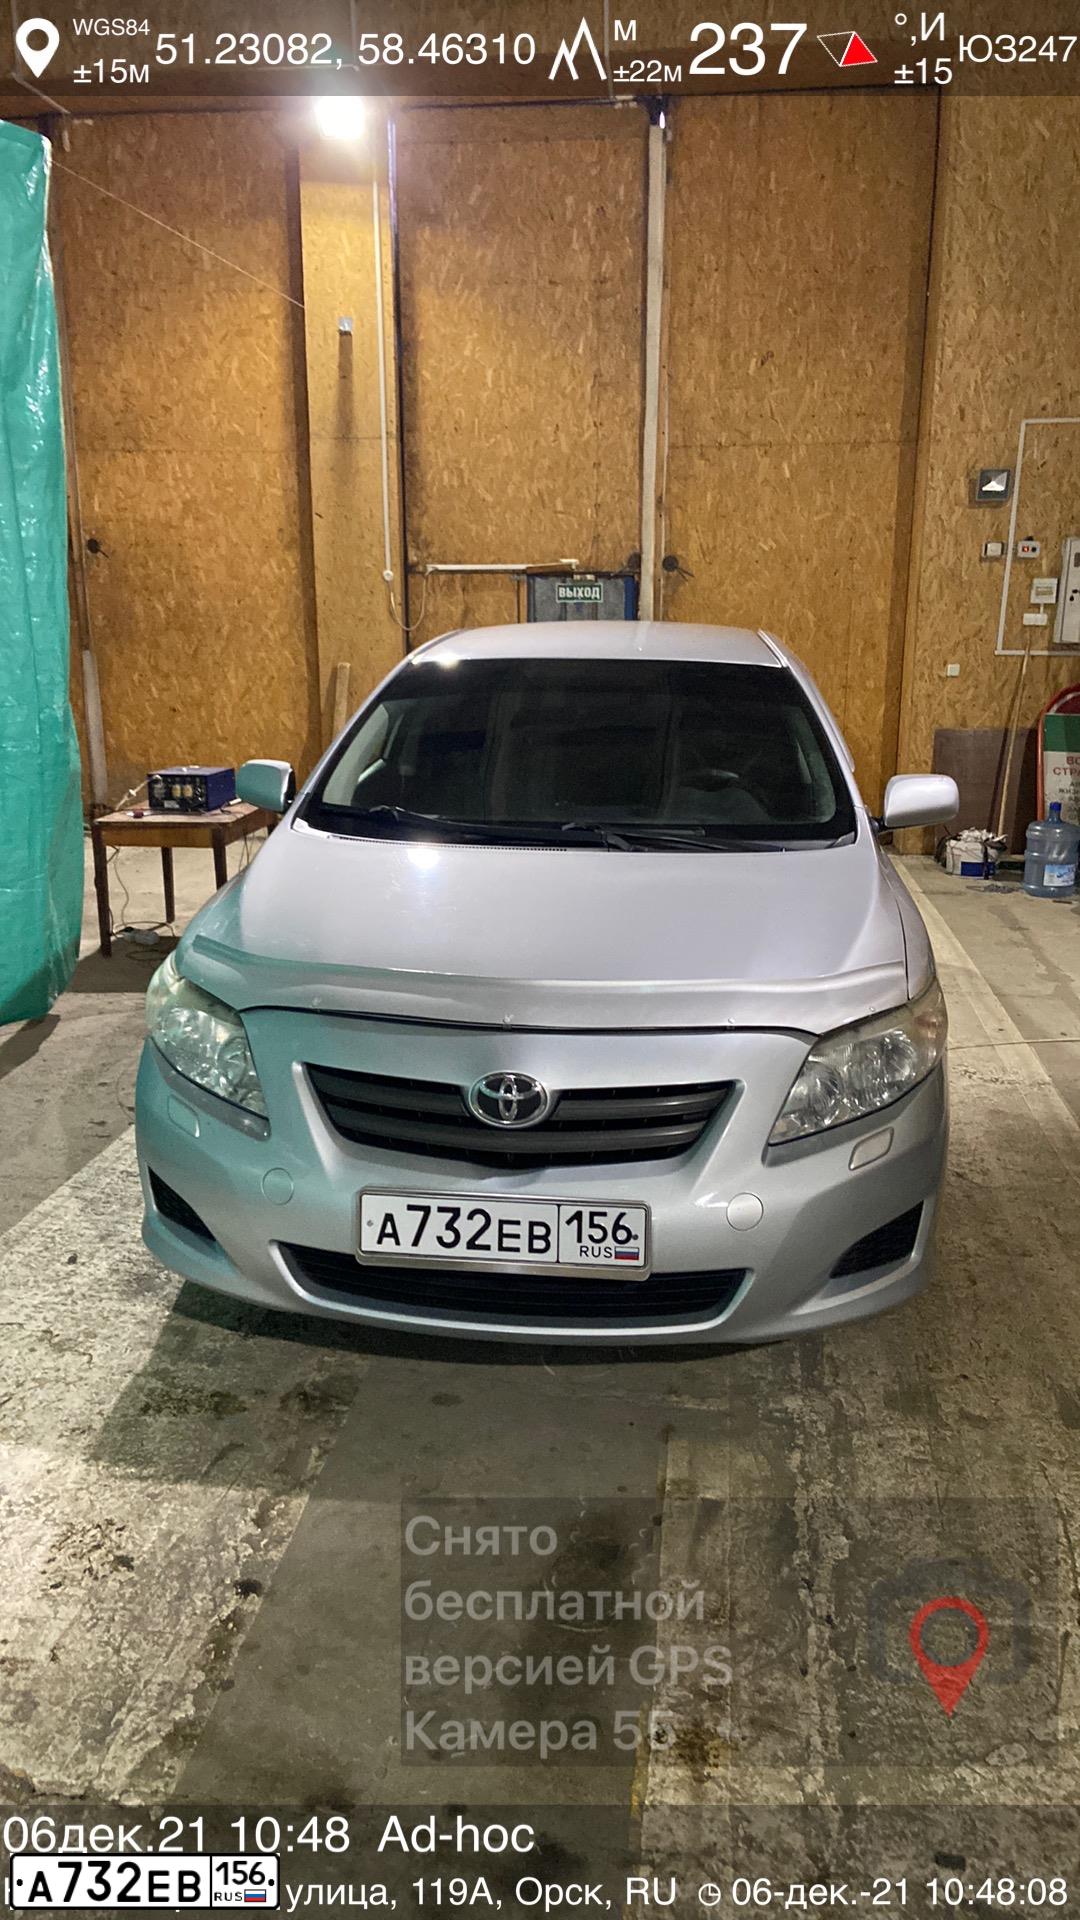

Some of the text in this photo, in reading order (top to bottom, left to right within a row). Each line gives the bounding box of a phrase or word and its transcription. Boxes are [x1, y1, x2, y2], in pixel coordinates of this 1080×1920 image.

[558, 586, 600, 600] ВЫХОД
[376, 1204, 633, 1254] А732ЕВ 156
[579, 1245, 612, 1259] RUS
